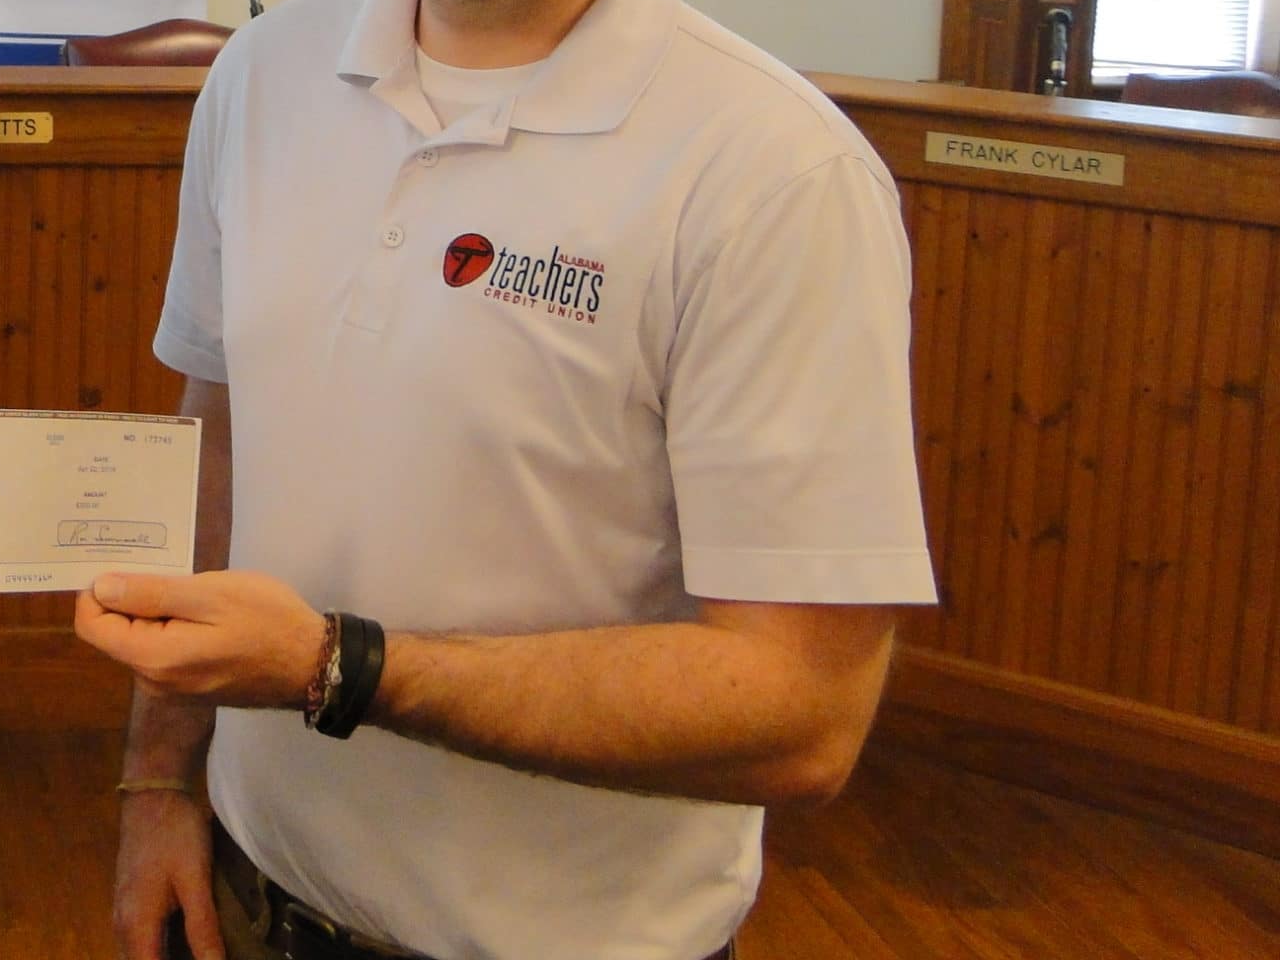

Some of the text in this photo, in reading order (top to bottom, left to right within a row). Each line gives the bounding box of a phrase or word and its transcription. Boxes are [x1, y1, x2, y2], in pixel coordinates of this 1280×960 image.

[946, 140, 1102, 175] FRANK CYLAR
[489, 245, 603, 313] teachers
[557, 253, 606, 273] ALABAMA
[483, 287, 597, 325] CREDIT UNION
